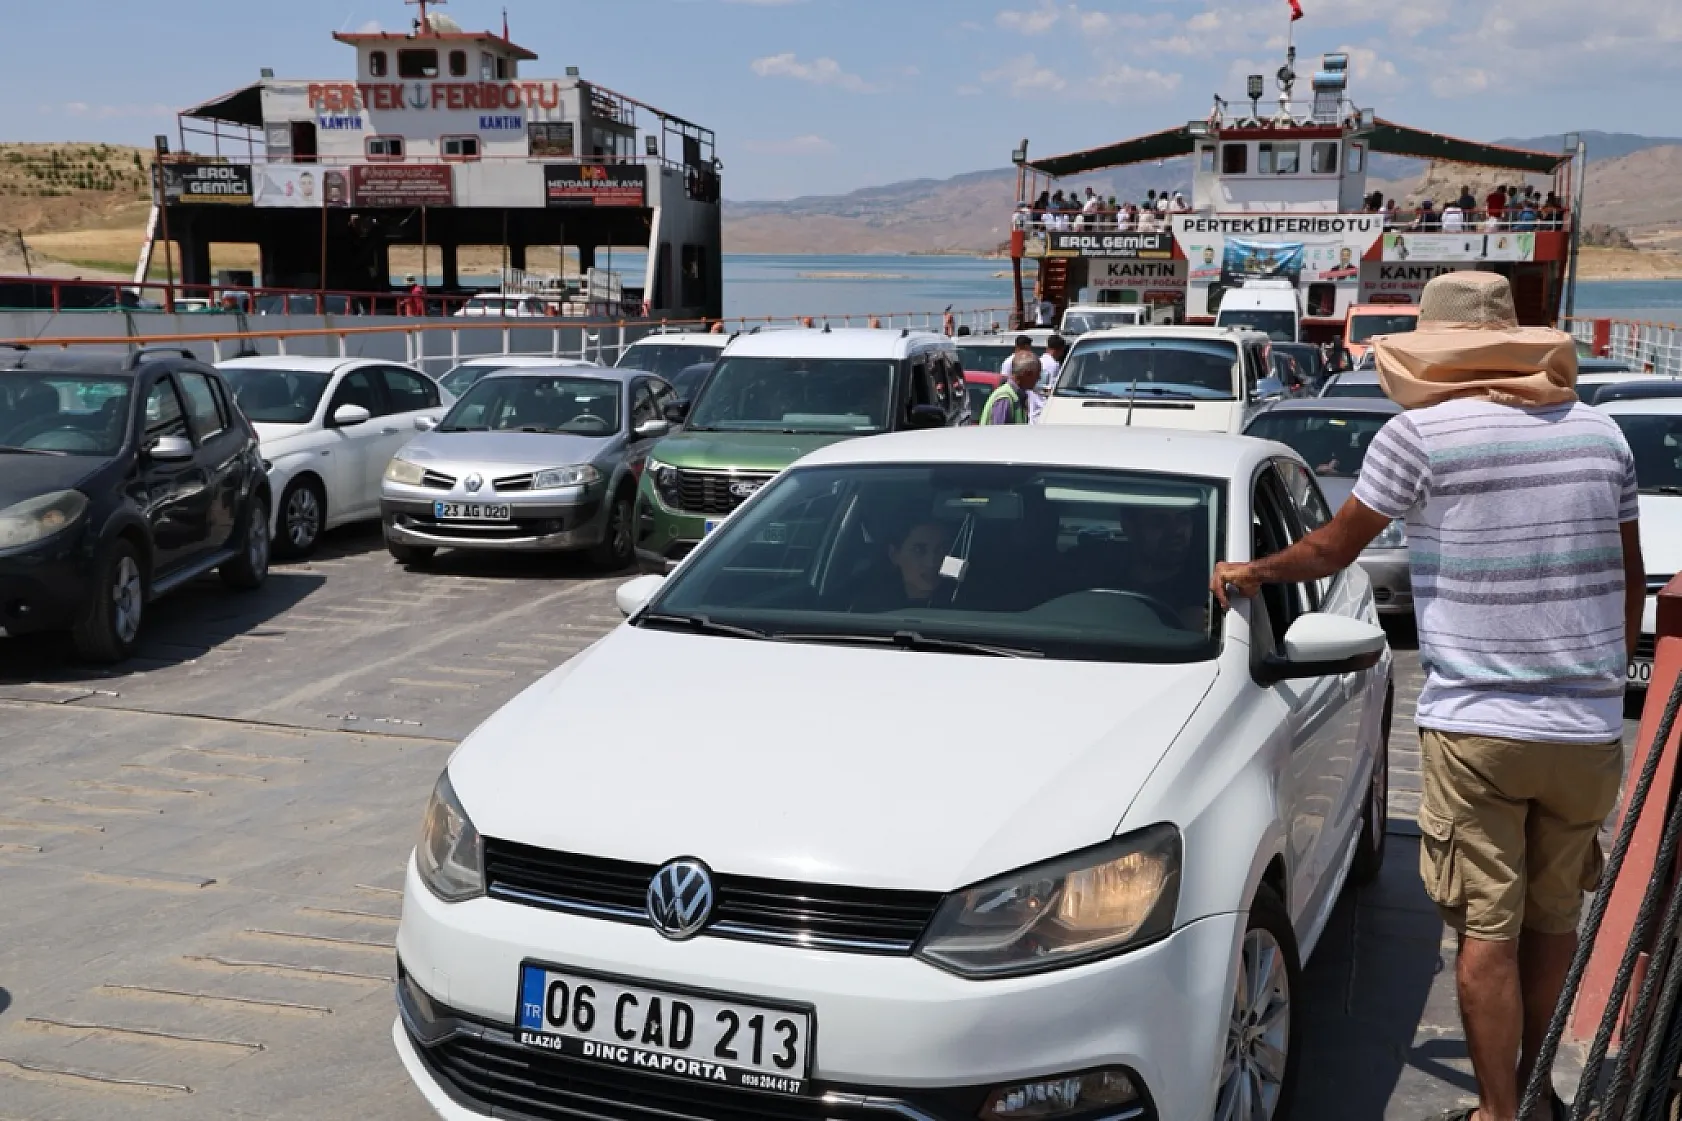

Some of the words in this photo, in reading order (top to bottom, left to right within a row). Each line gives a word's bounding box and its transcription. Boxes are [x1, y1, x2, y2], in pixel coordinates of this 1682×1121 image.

[308, 82, 406, 109] PERTEK
[431, 81, 560, 109] FERİBOTU
[198, 167, 239, 179] EROL
[1183, 218, 1255, 233] PERTEK
[1275, 217, 1371, 233] FERİBOTU
[1060, 236, 1101, 248] EROL
[1108, 262, 1175, 277] KANTİN
[444, 504, 458, 517] 23
[464, 504, 480, 517] AG
[485, 504, 508, 519] 020
[524, 1002, 542, 1019] TR
[545, 979, 596, 1032] 06
[614, 992, 694, 1050] CAD
[714, 1009, 799, 1069] 213
[633, 1050, 727, 1081] KAPORTA
